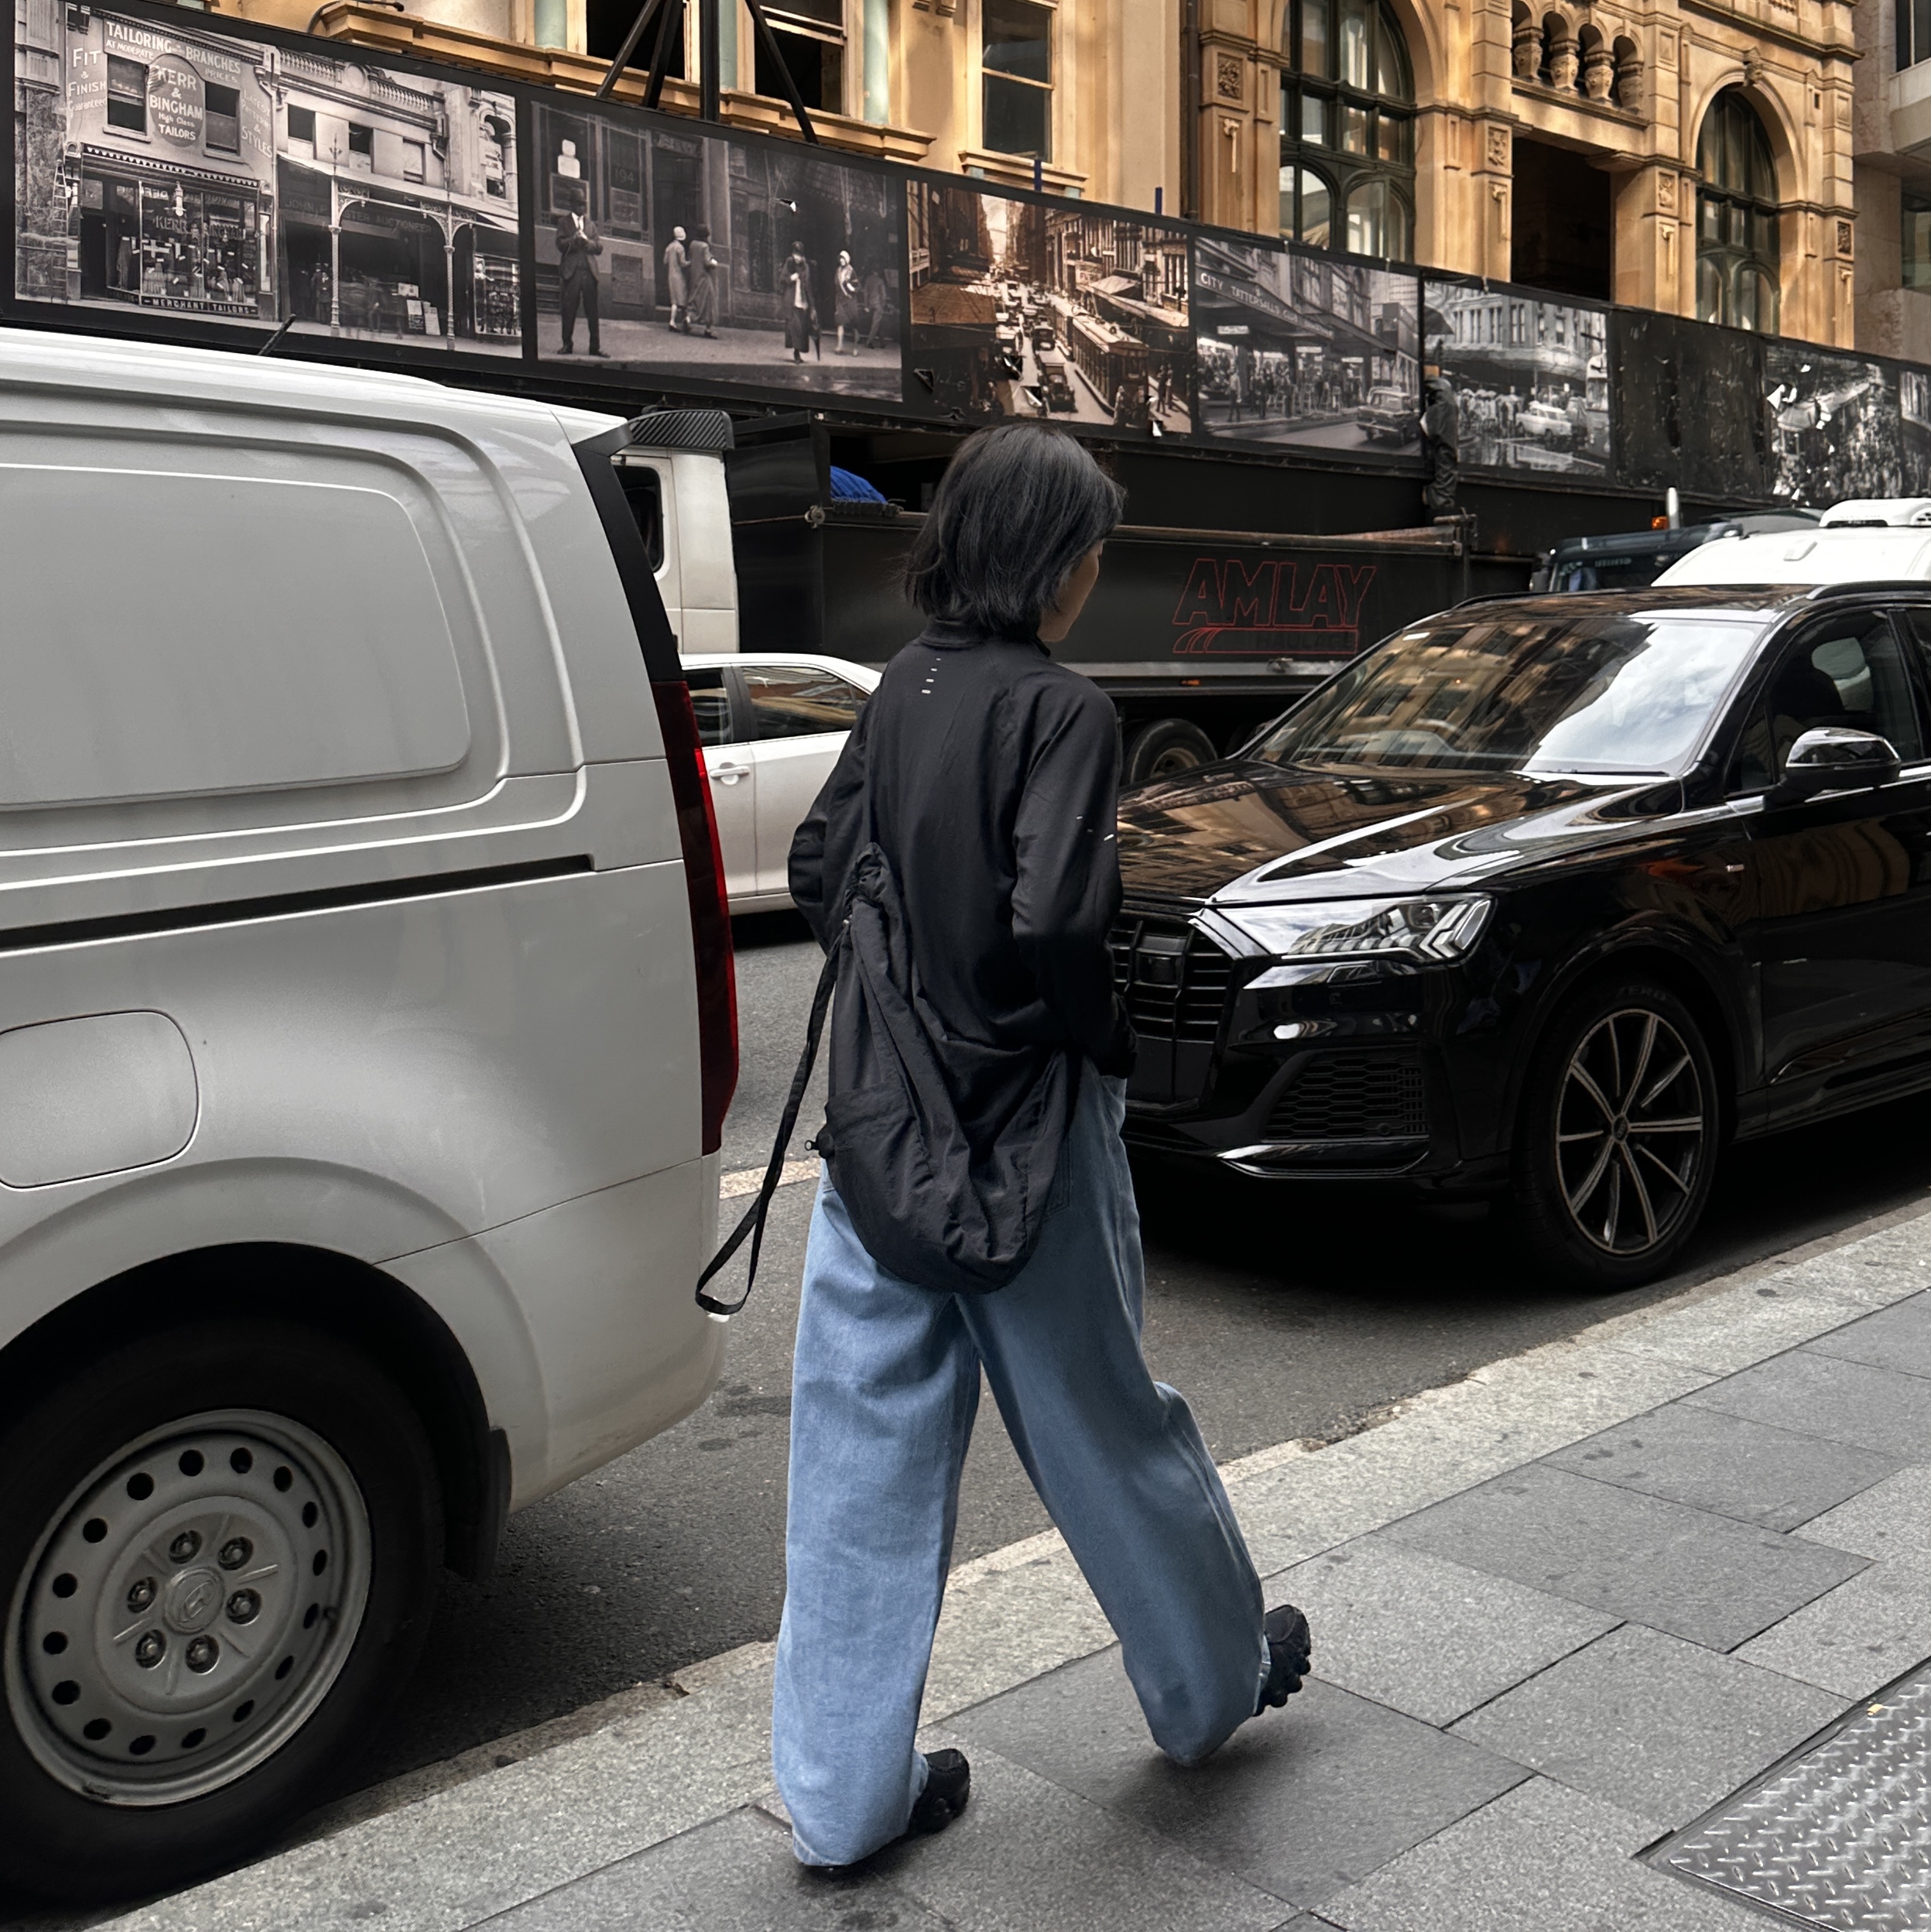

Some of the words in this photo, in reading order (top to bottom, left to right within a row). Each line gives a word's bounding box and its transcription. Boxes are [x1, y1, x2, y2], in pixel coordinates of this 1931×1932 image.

[107, 21, 172, 53] TAILORING
[186, 46, 241, 74] BRANCHES
[73, 48, 102, 67] FIT
[106, 40, 116, 49] AT
[117, 43, 154, 60] MODERATE
[204, 68, 238, 84] PRICES
[80, 71, 89, 79] &
[155, 65, 197, 91] KERR
[68, 80, 106, 97] FINISH
[171, 87, 181, 99] &
[149, 95, 202, 120] BINGHAM
[158, 124, 196, 141] TAILORS
[241, 125, 273, 158] STYLES
[1200, 272, 1224, 291] CITY
[153, 298, 204, 310] MERCHANT
[212, 304, 249, 314] TAILORS
[1172, 558, 1377, 628] AMLAY
